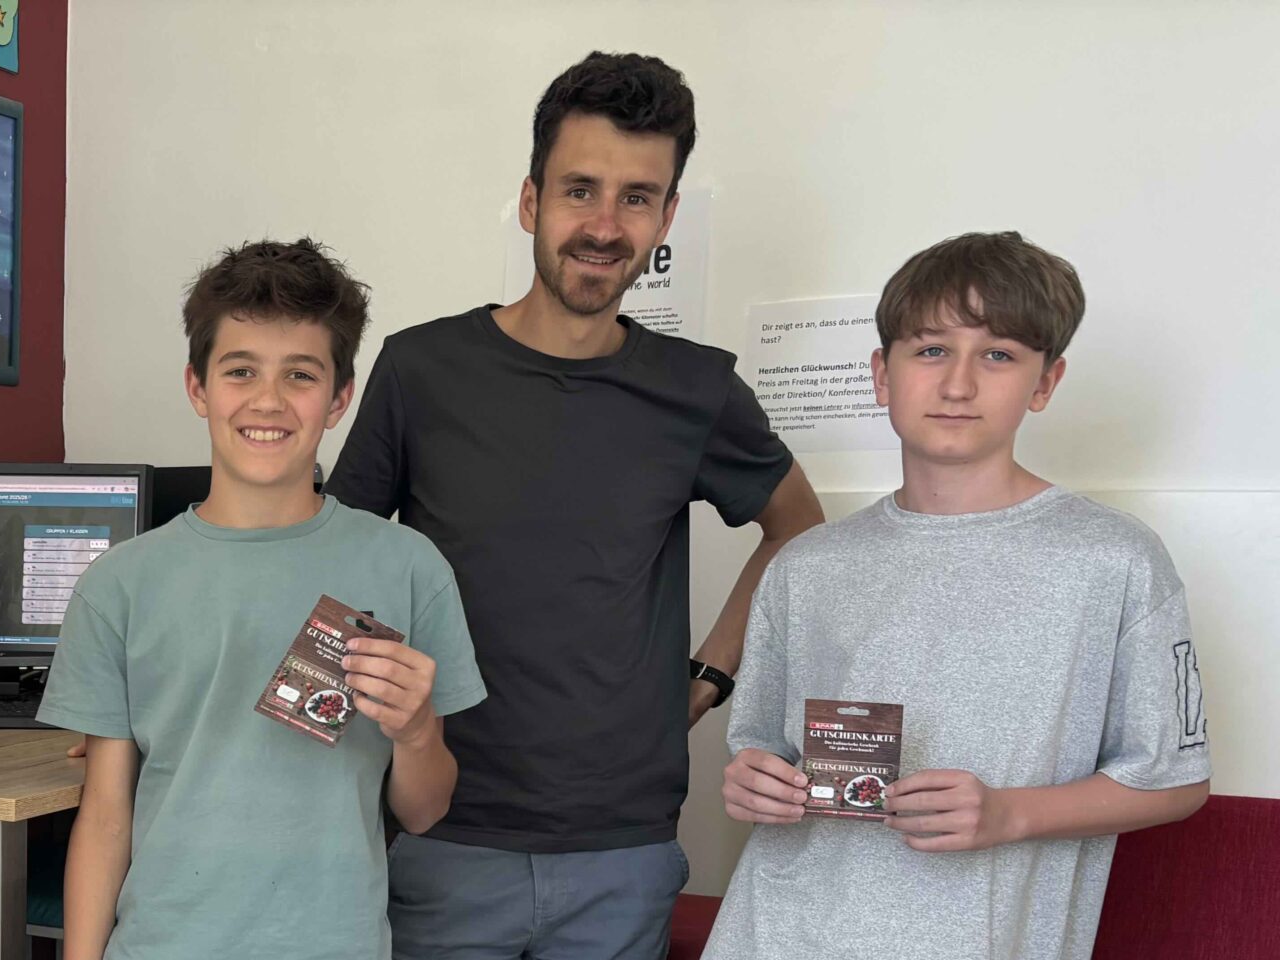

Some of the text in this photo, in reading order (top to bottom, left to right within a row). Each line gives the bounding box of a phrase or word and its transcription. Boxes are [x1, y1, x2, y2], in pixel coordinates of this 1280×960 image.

[647, 277, 671, 290] world
[762, 323, 773, 332] Dir
[775, 321, 793, 331] zeigt
[805, 321, 817, 329] an,
[819, 319, 837, 327] dass
[838, 318, 849, 326] du
[851, 317, 874, 325] einen
[760, 335, 782, 344] hast?
[758, 366, 799, 375] Herzlichen
[801, 362, 857, 373] Glückwunsch!
[757, 379, 776, 388] Preis
[792, 377, 819, 387] Freitag
[820, 376, 828, 384] in
[829, 375, 843, 384] der
[845, 374, 873, 384] großen
[772, 391, 785, 400] der
[787, 389, 827, 399] Direktion/
[803, 404, 823, 412] keinen
[809, 729, 897, 744] GUTSCHEINKARTE
[811, 762, 889, 776] GUTSCHEINKARTE
